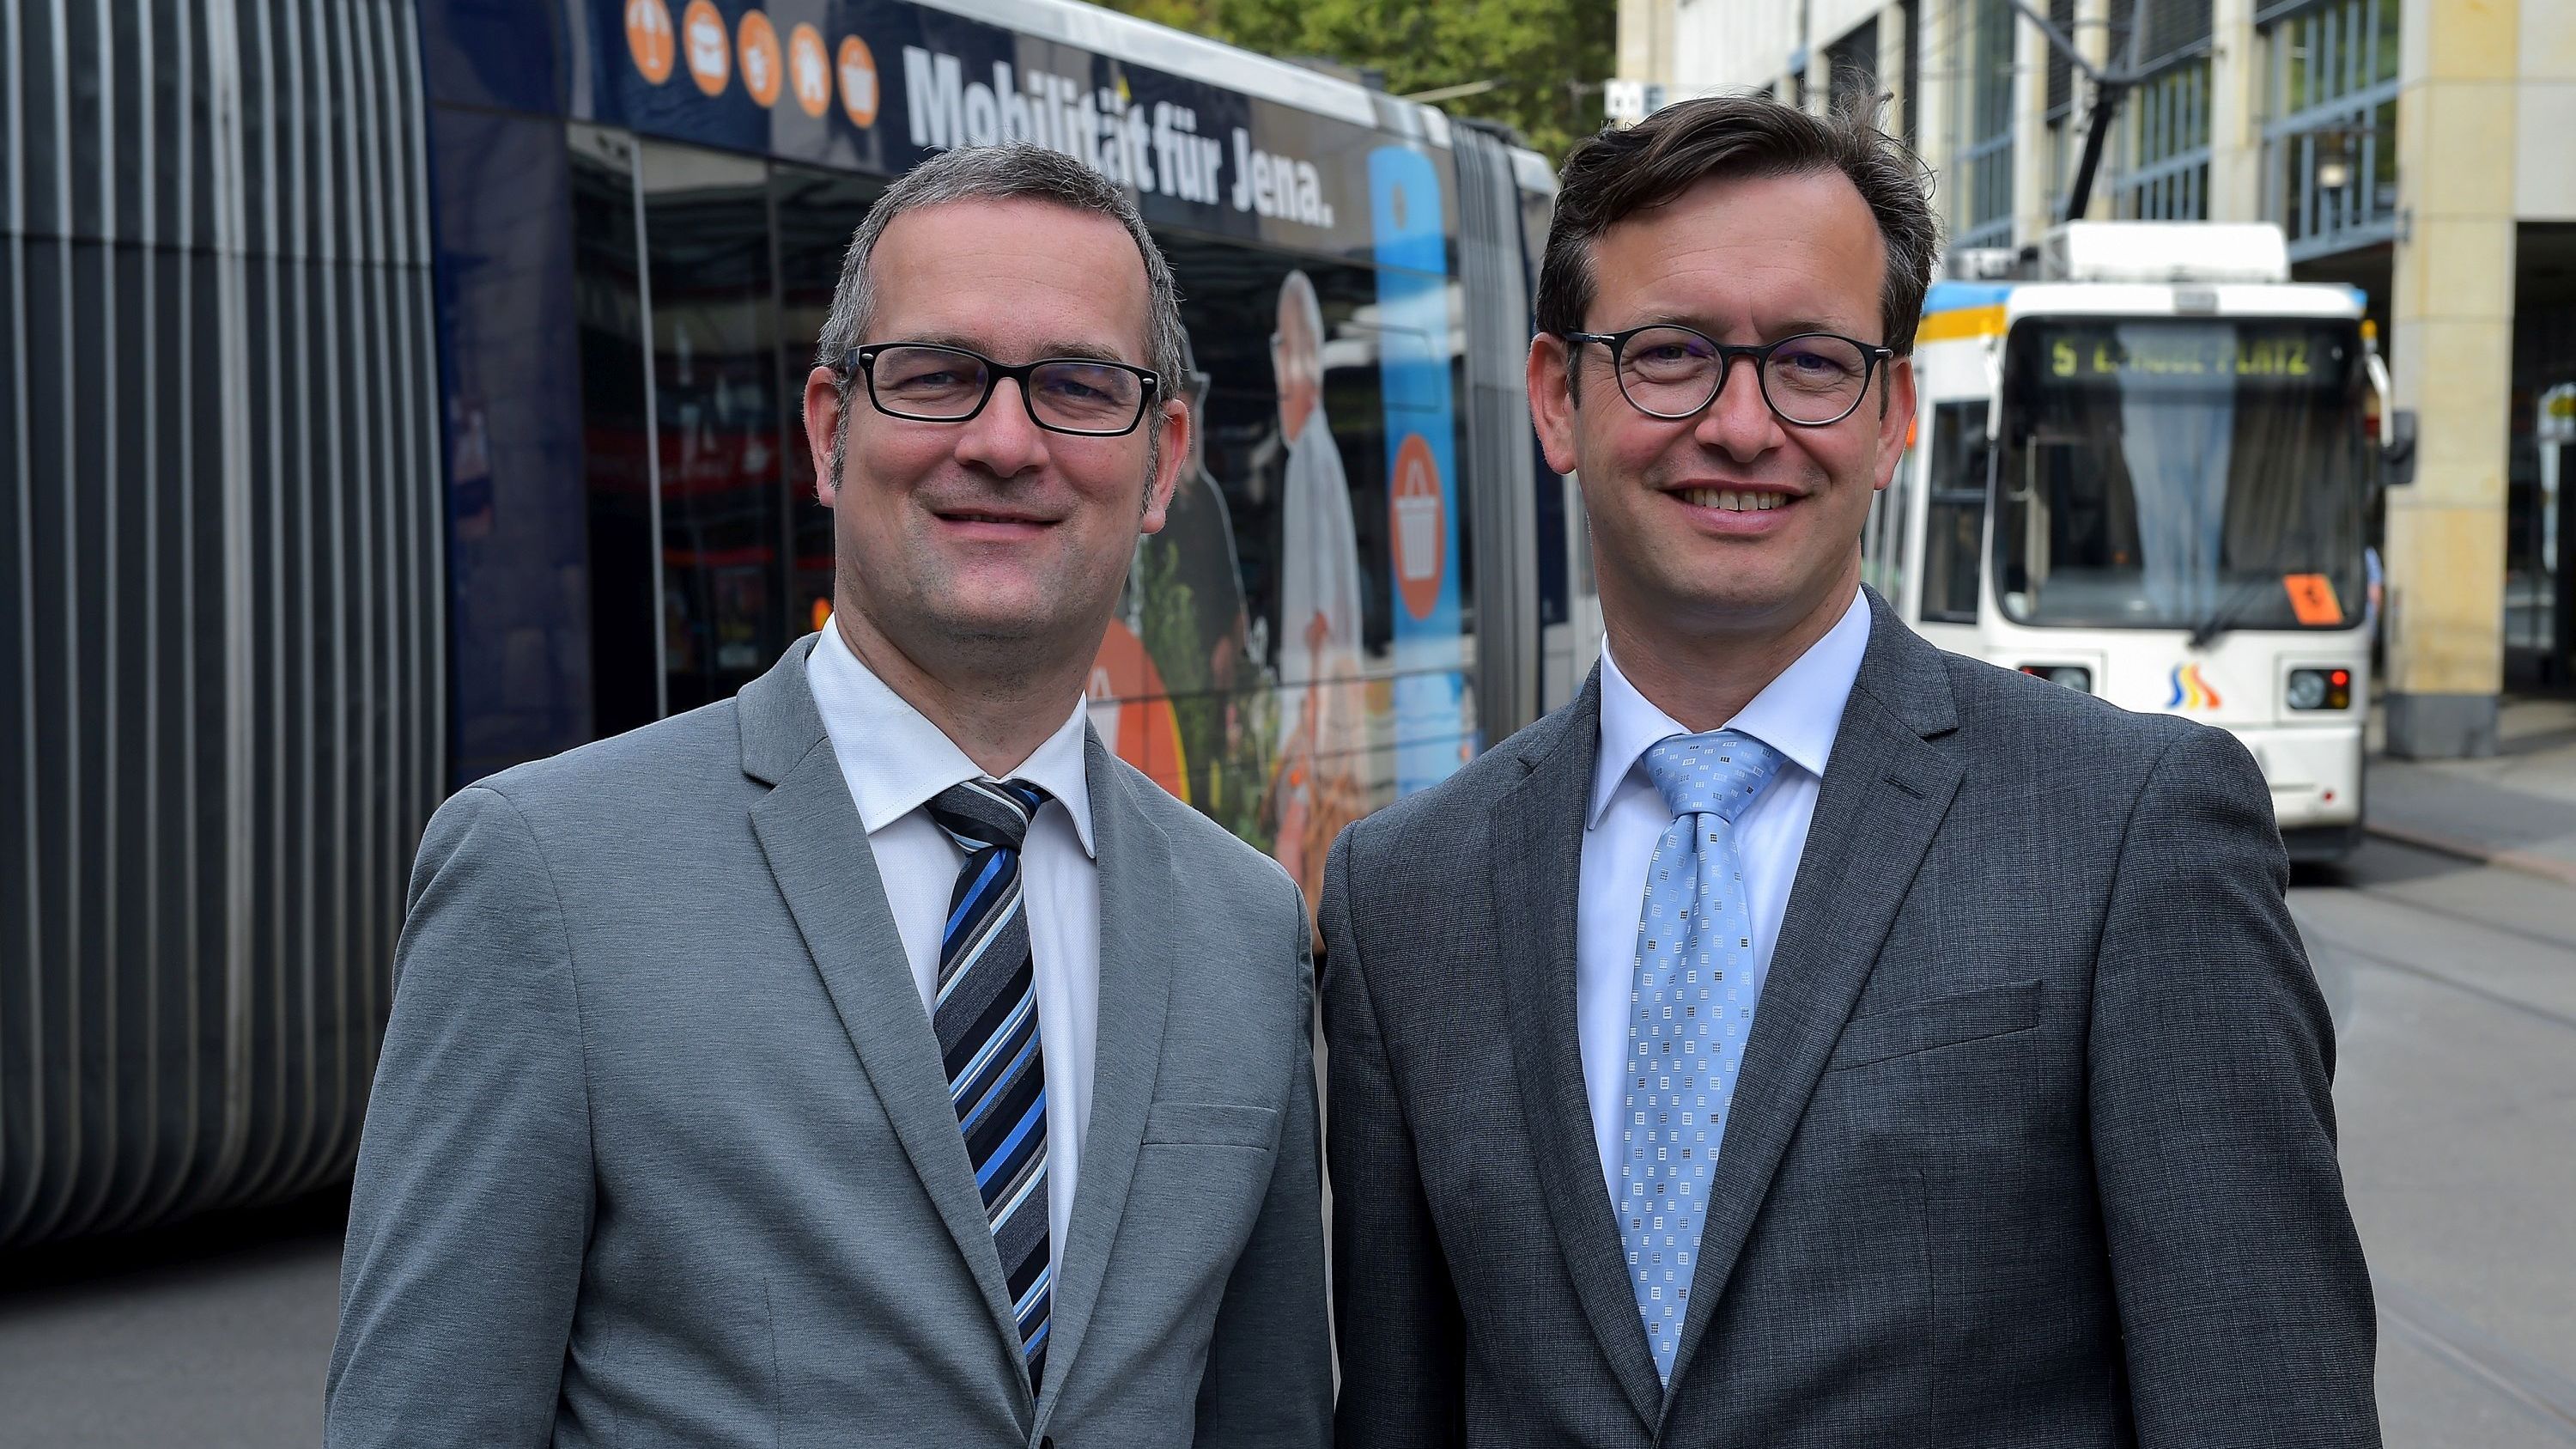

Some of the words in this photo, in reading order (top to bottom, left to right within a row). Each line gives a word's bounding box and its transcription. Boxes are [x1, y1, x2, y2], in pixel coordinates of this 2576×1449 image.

[902, 45, 1156, 192] Mobilität
[1153, 100, 1222, 205] für
[1231, 126, 1334, 228] Jena.
